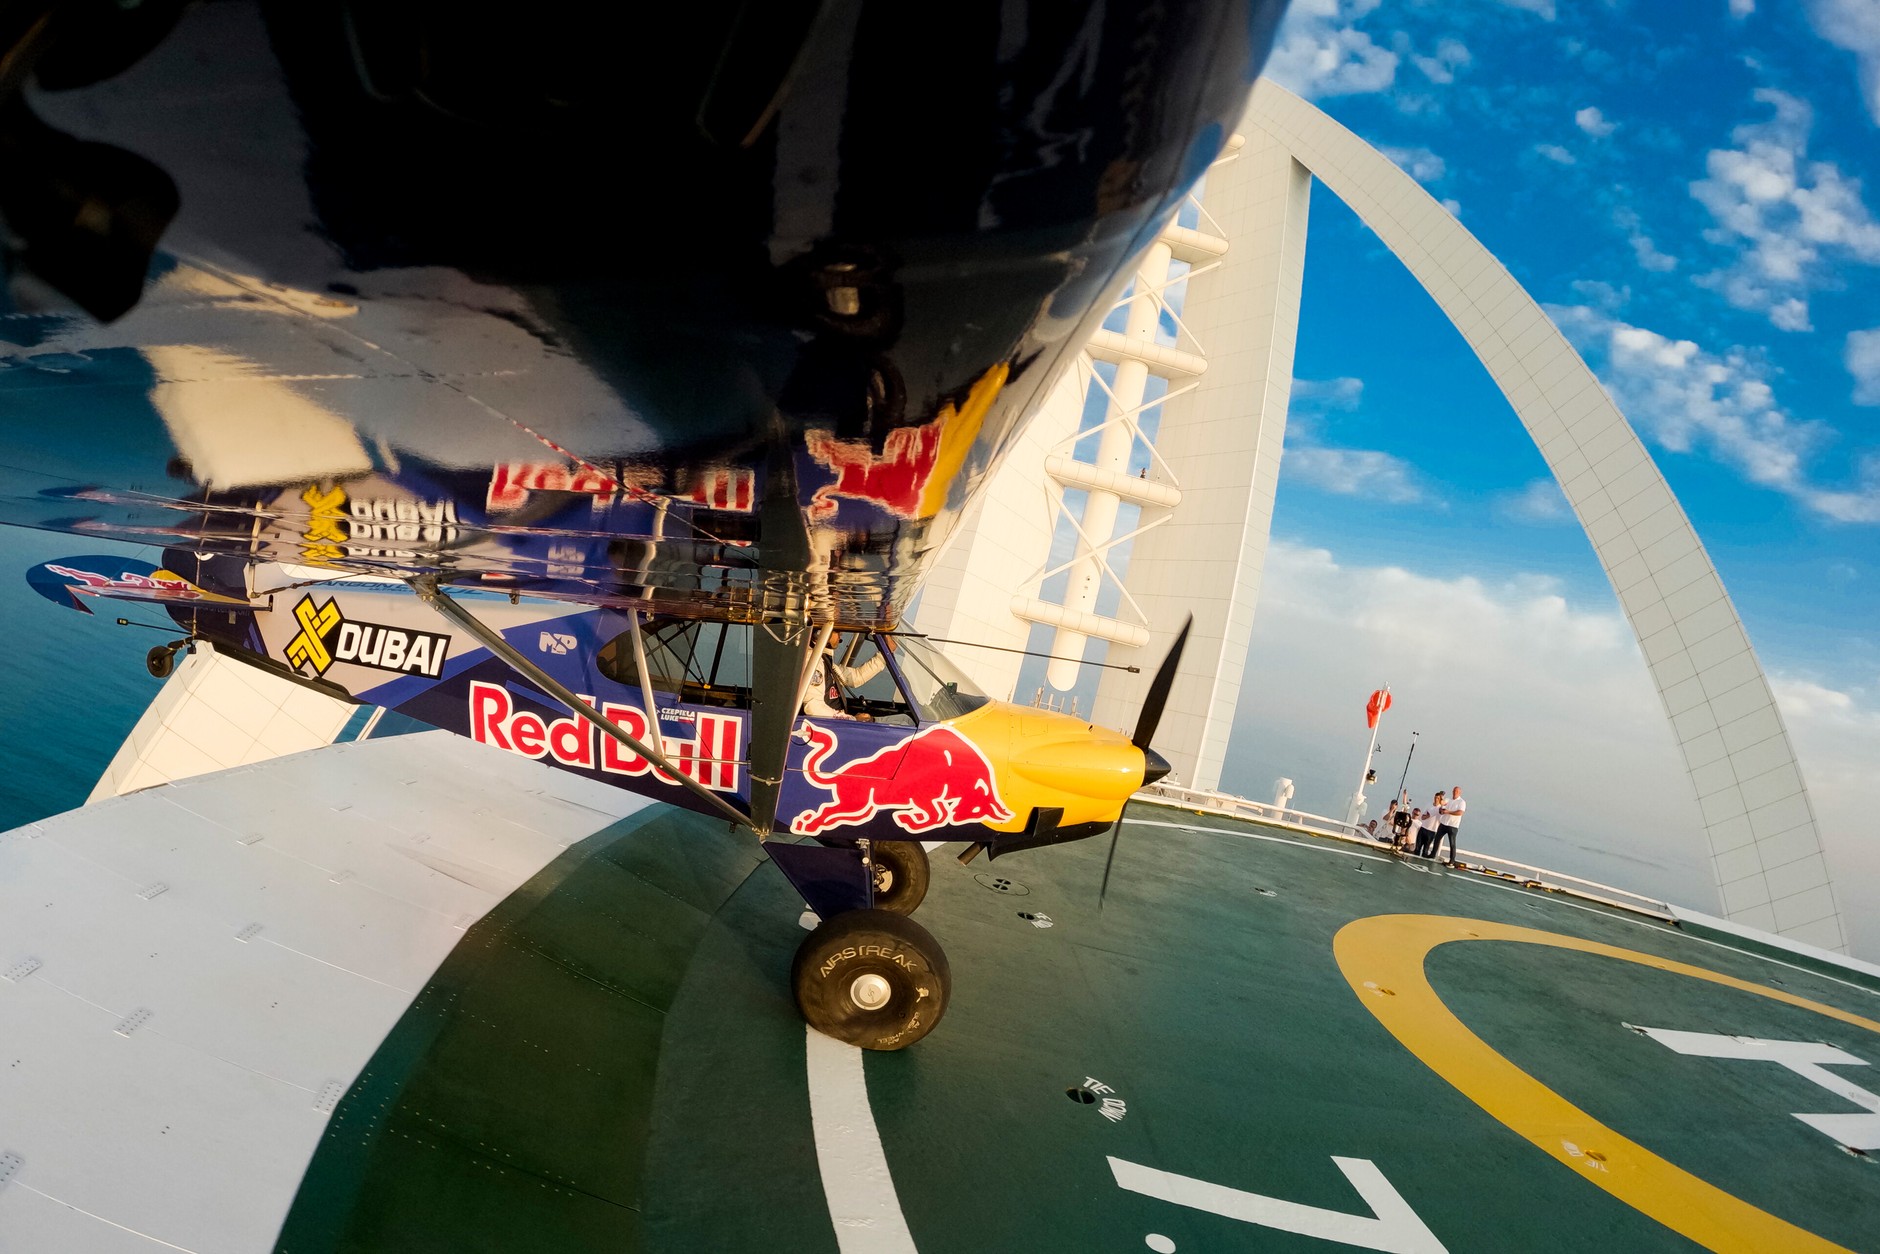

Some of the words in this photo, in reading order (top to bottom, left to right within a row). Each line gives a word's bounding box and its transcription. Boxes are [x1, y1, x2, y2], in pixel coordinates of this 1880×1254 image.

[337, 623, 446, 676] DUBAI
[660, 714, 679, 722] LUKE
[470, 681, 596, 768] Red
[601, 702, 742, 793] Bull
[820, 945, 917, 978] AIRSTREAK
[1083, 1076, 1116, 1094] TIE
